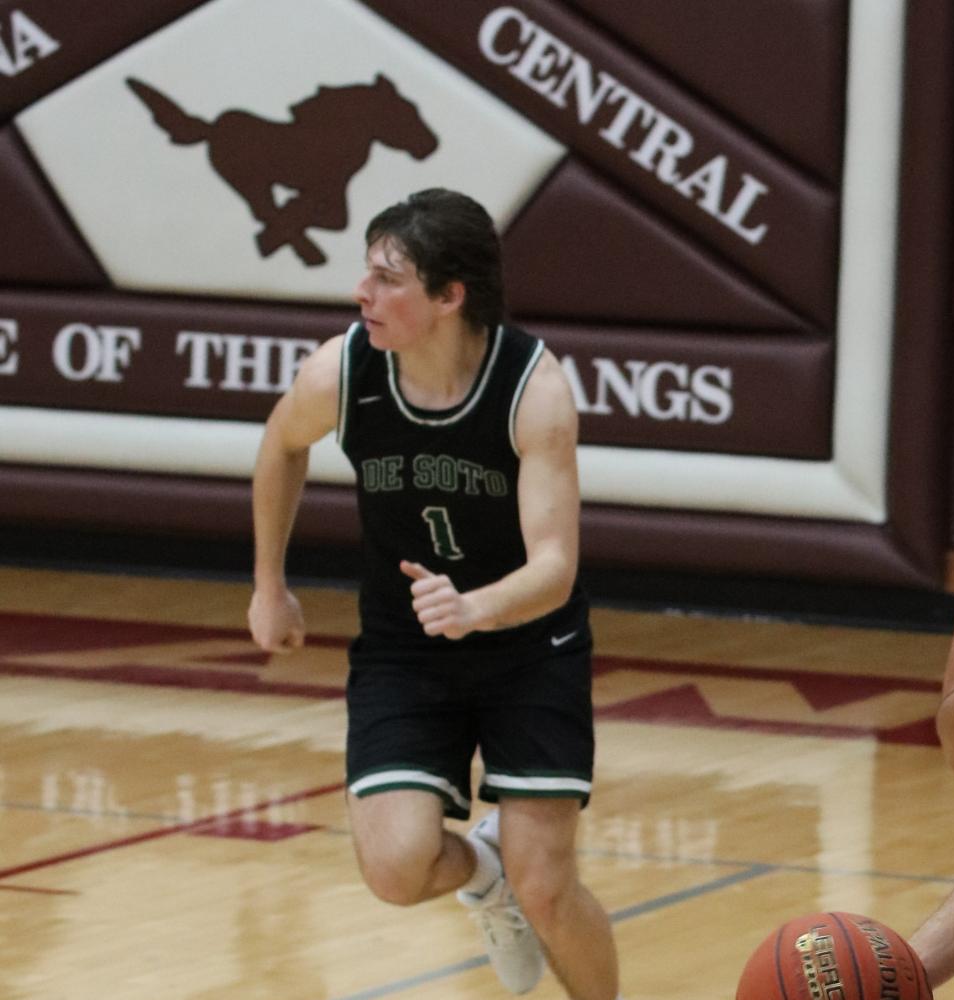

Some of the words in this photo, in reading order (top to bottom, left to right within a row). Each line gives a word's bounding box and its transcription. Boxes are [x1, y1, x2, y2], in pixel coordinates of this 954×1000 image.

[477, 5, 769, 245] CENTRAL
[52, 322, 142, 382] OF
[361, 455, 404, 493] DE
[412, 453, 508, 497] SOTO
[421, 506, 465, 560] 1
